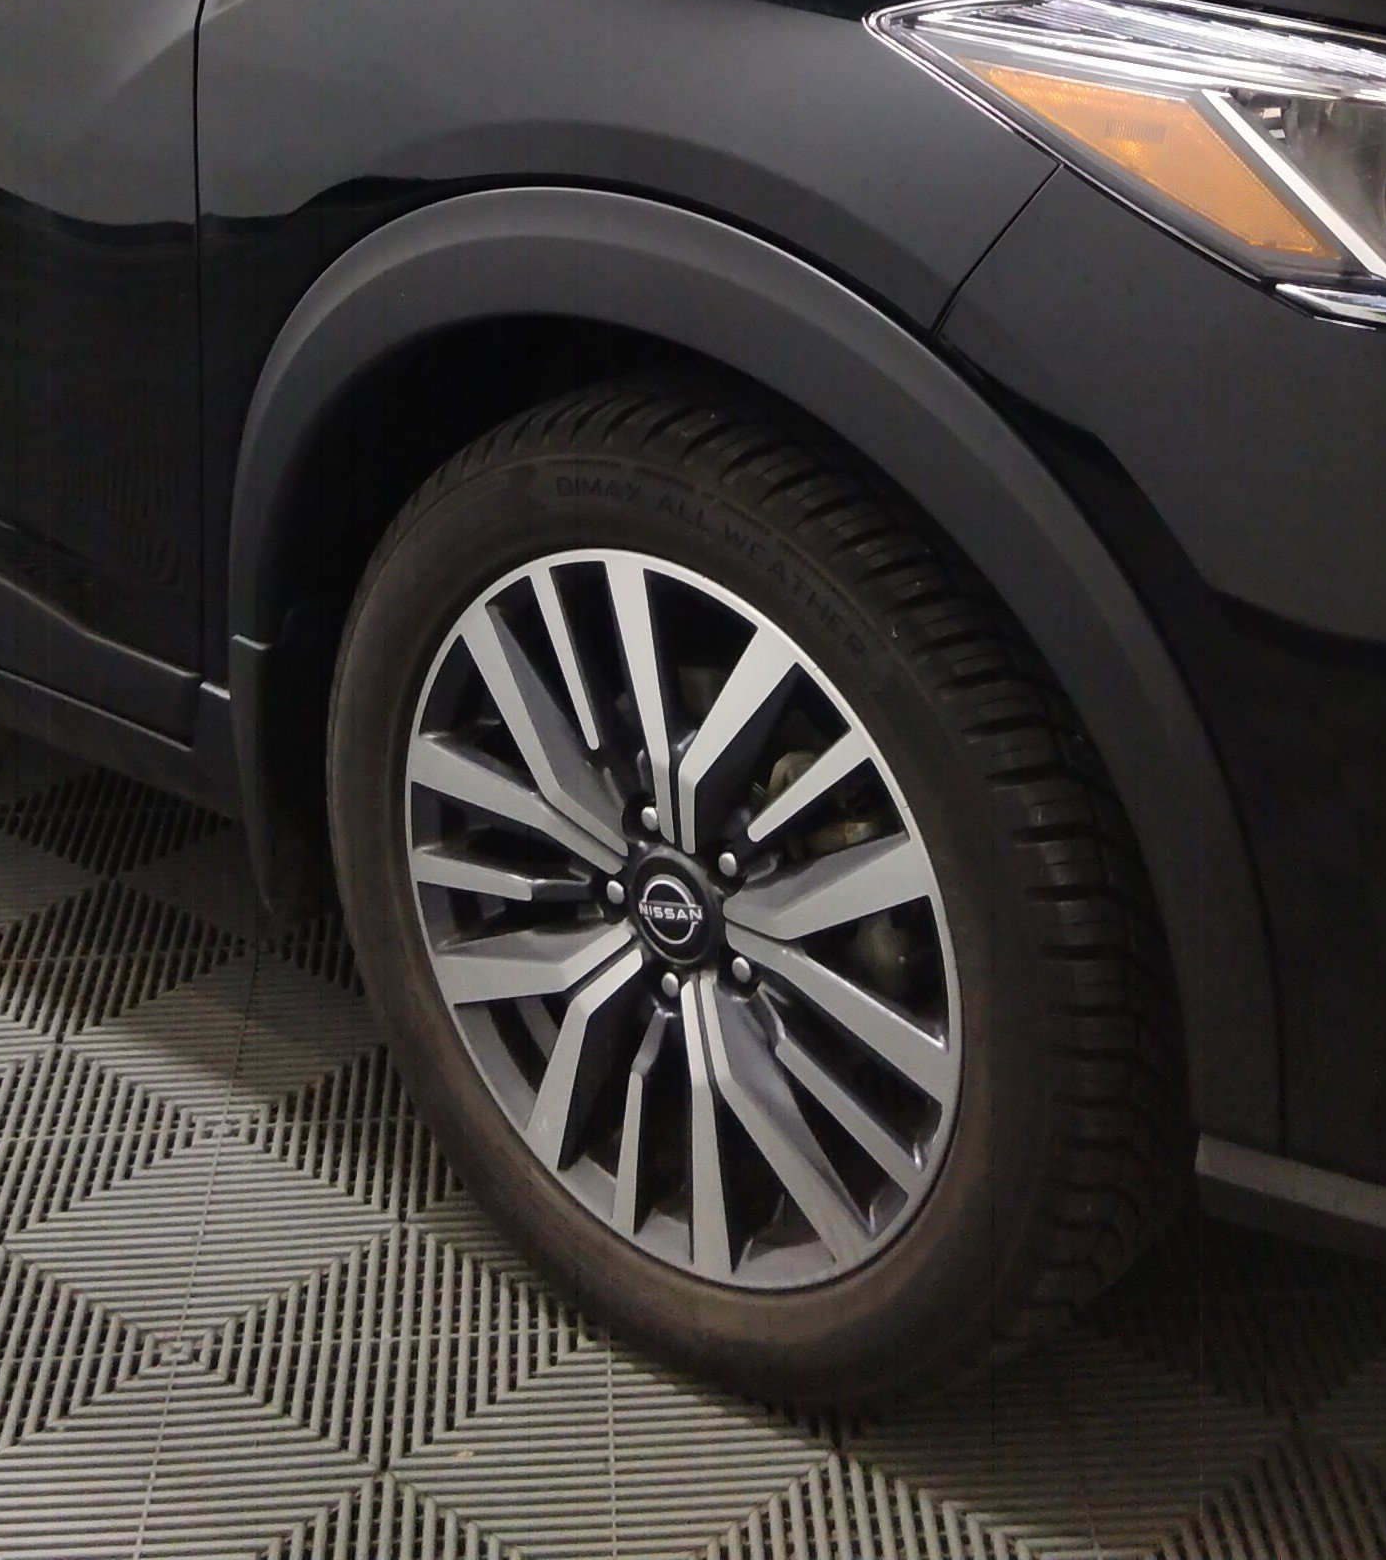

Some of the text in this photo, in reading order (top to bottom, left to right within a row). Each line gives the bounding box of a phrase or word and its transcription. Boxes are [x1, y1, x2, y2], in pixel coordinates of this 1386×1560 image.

[656, 493, 707, 533] ALL
[723, 522, 867, 657] WEATHER
[638, 901, 703, 922] NISSAN
